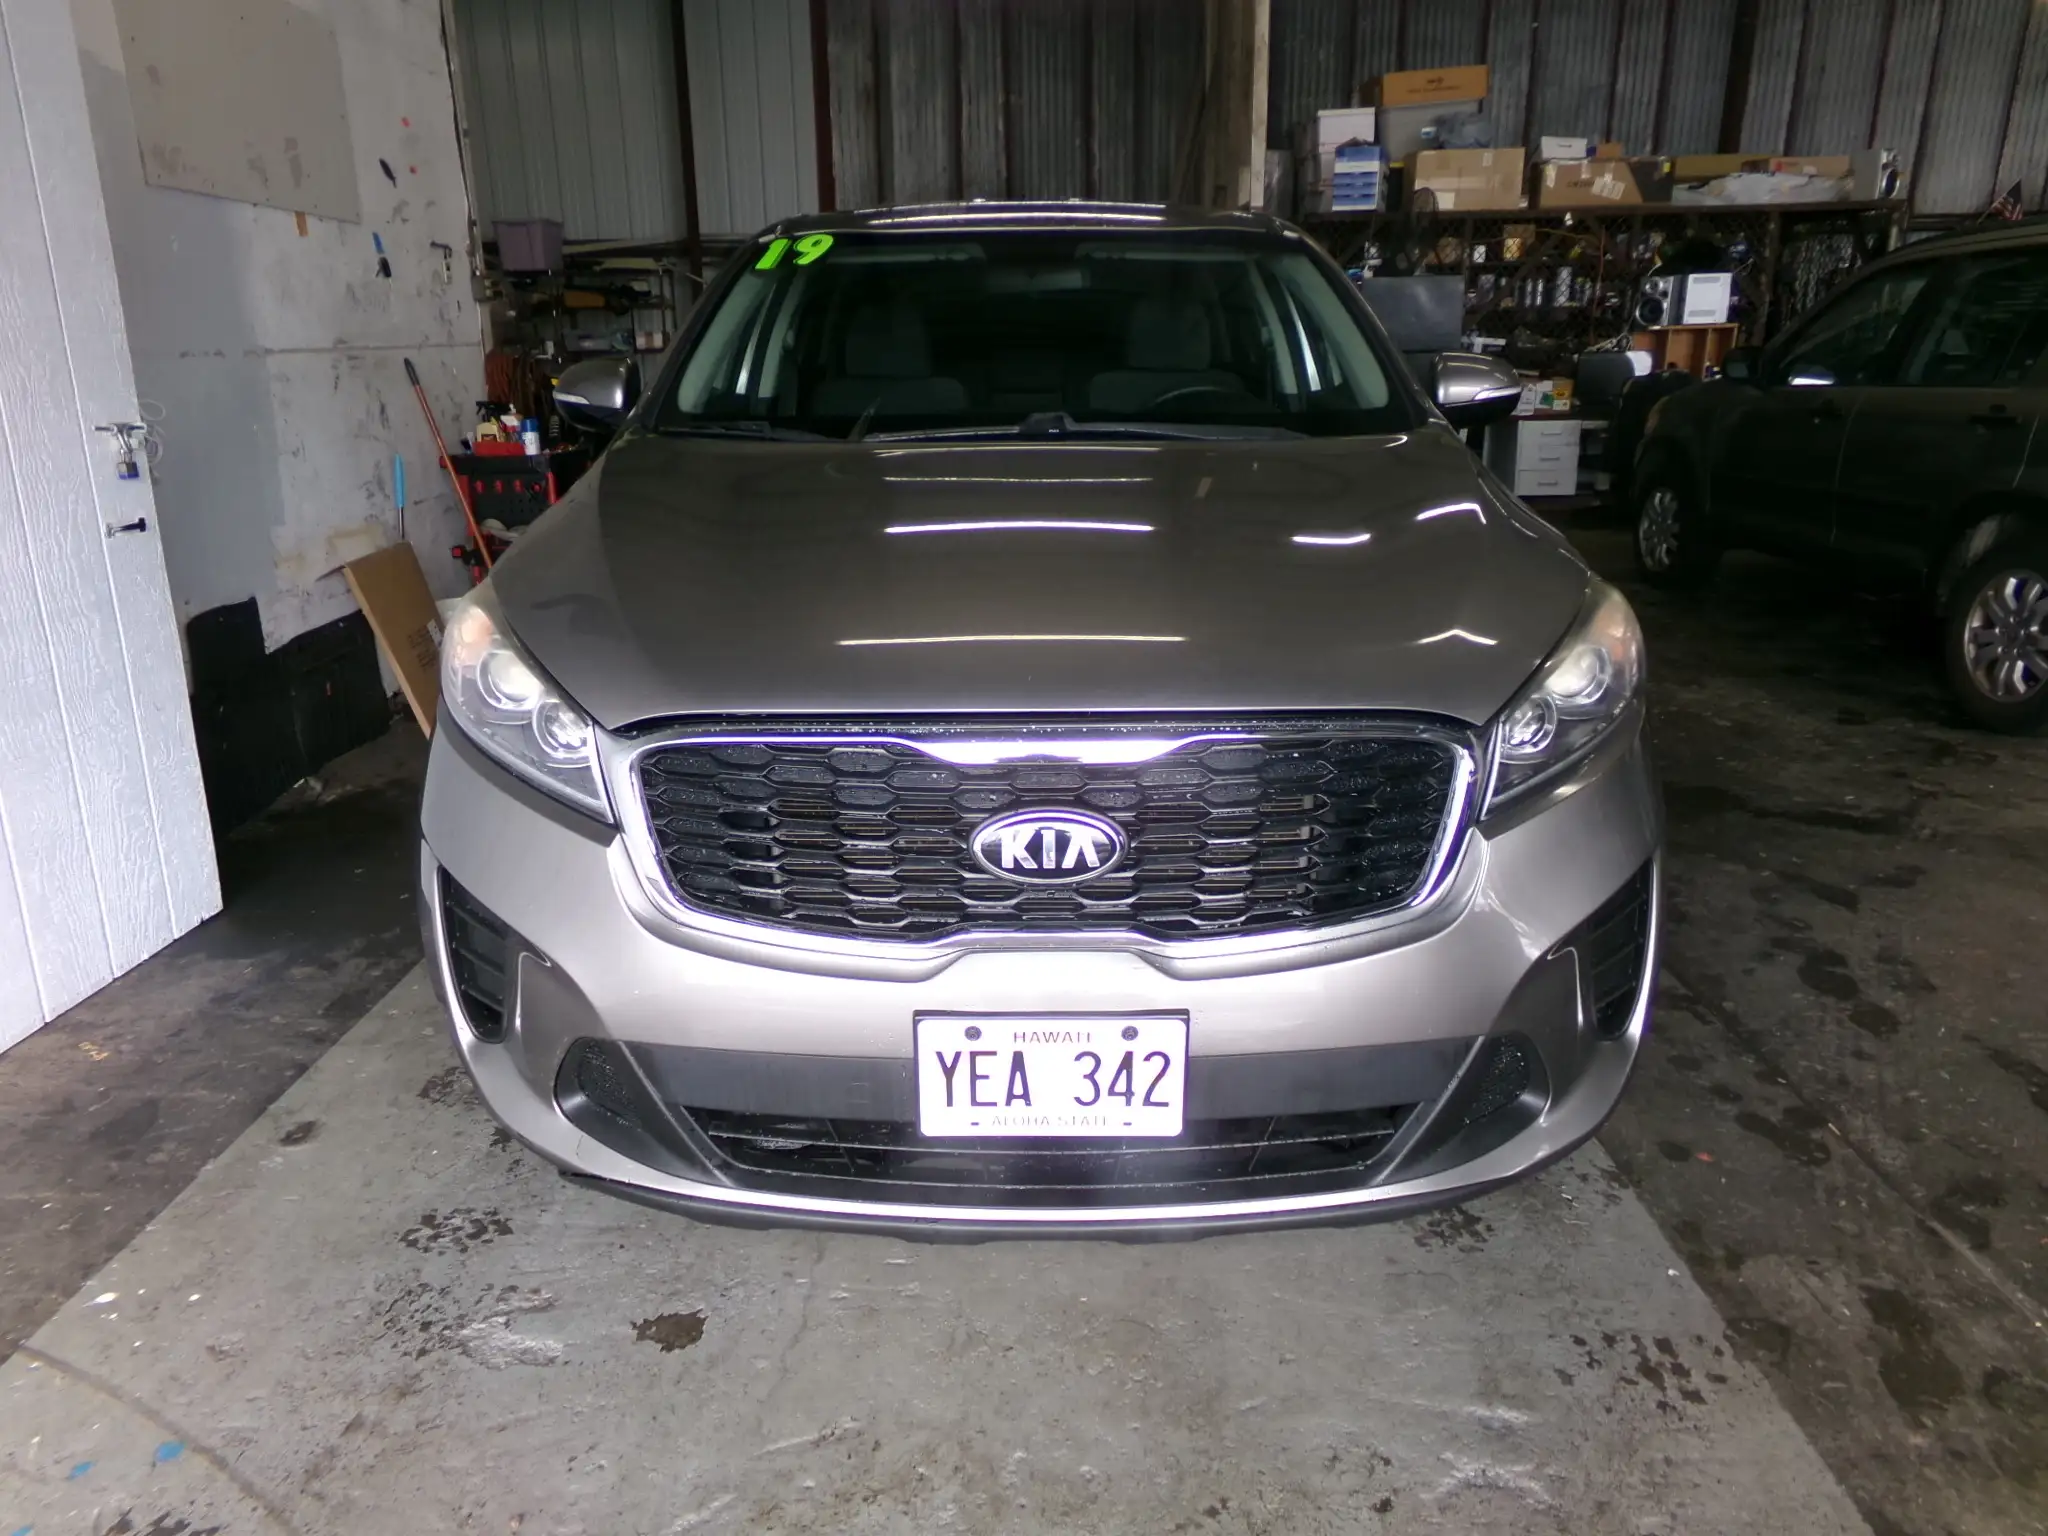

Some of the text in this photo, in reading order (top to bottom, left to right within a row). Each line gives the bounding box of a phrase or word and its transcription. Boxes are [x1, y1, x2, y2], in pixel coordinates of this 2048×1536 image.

[754, 233, 834, 270] 19
[1000, 826, 1101, 869] KIA
[1013, 1031, 1091, 1044] HAWAII
[935, 1050, 1172, 1108] YEA 342
[992, 1115, 1050, 1127] ALOHA
